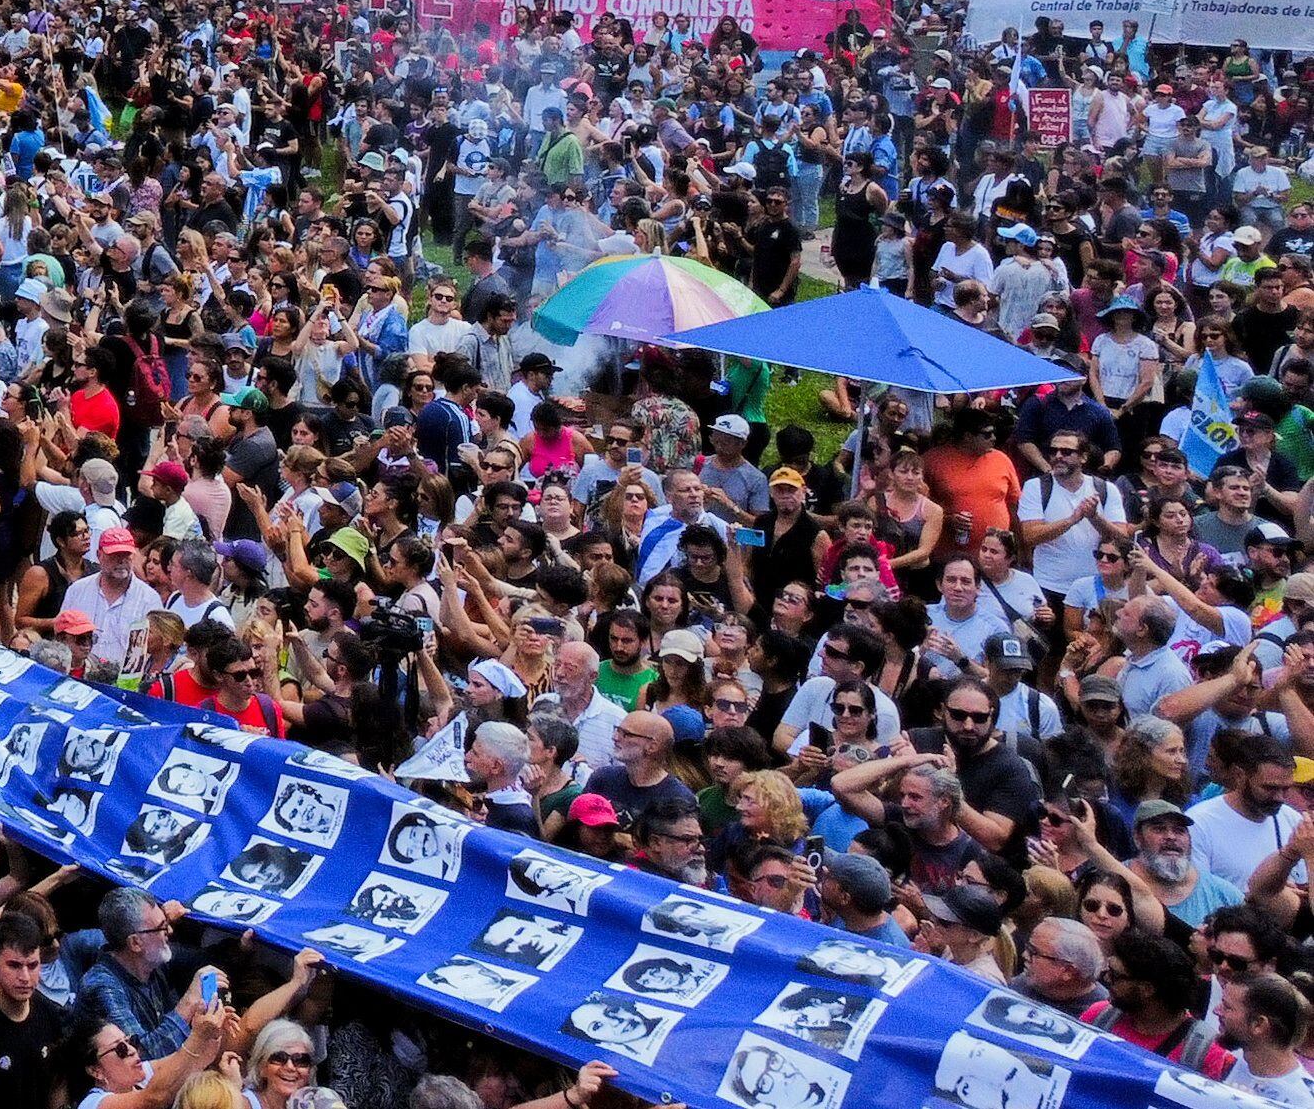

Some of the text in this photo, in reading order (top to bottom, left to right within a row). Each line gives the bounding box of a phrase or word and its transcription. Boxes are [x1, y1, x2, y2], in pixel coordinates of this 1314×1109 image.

[1030, 0, 1074, 13] Central
[1076, 0, 1093, 12] de
[1190, 0, 1279, 17] Trabajadoras
[1281, 4, 1302, 17] de
